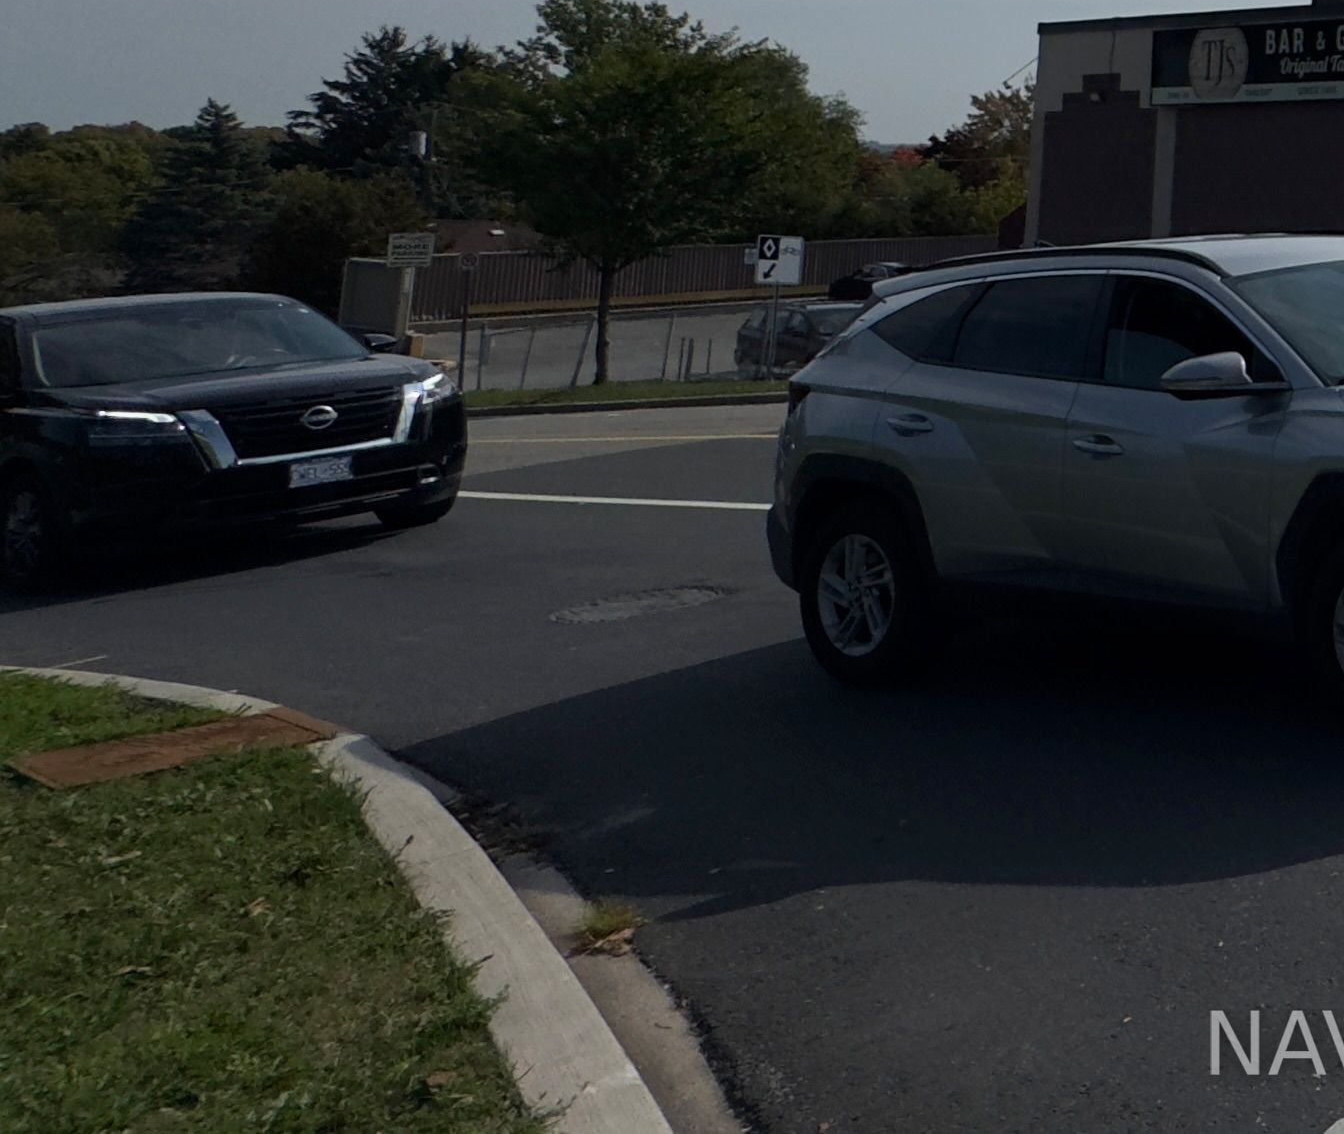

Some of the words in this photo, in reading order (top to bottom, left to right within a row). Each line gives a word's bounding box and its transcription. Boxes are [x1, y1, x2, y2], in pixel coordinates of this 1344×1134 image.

[1265, 27, 1304, 55] BAR
[1315, 30, 1326, 51] &
[1279, 56, 1328, 79] Original
